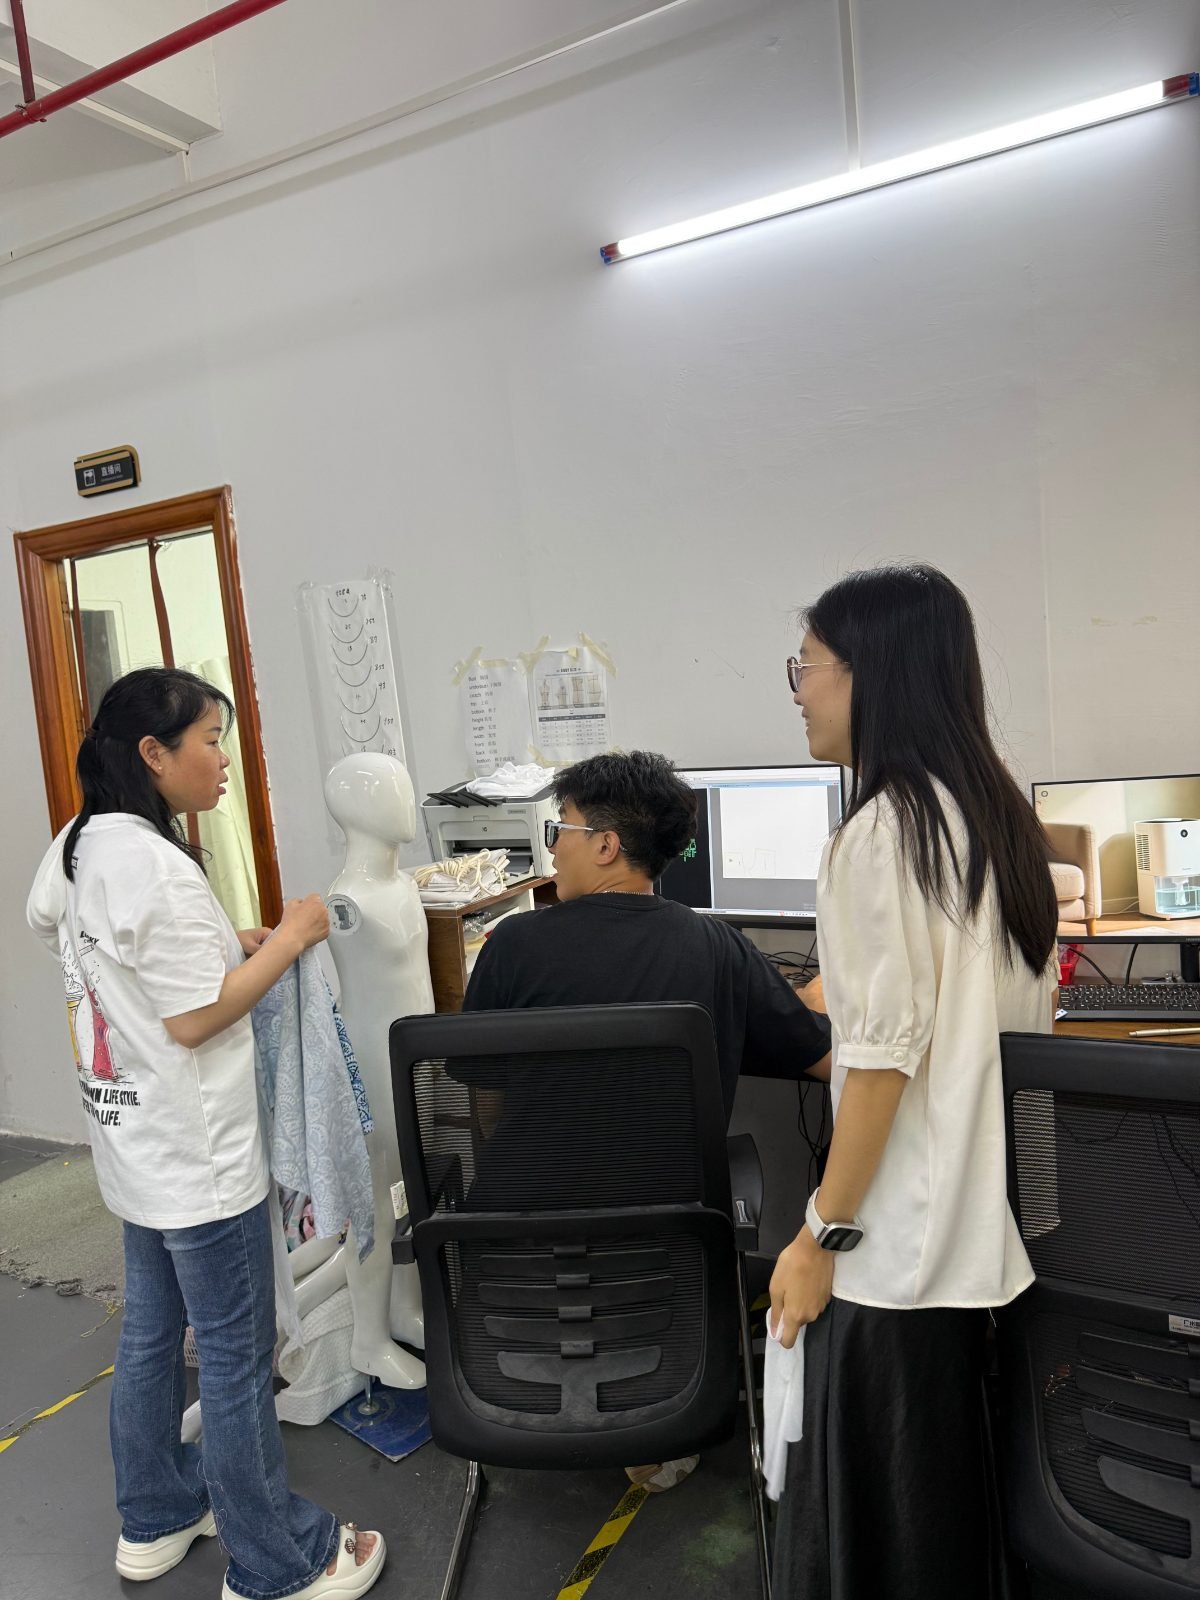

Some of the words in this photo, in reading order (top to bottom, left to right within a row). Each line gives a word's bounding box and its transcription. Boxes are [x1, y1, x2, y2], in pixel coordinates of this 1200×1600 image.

[103, 1088, 120, 1105] LIFE
[119, 1090, 141, 1106] STYLE.
[100, 1110, 121, 1126] LIFE.
